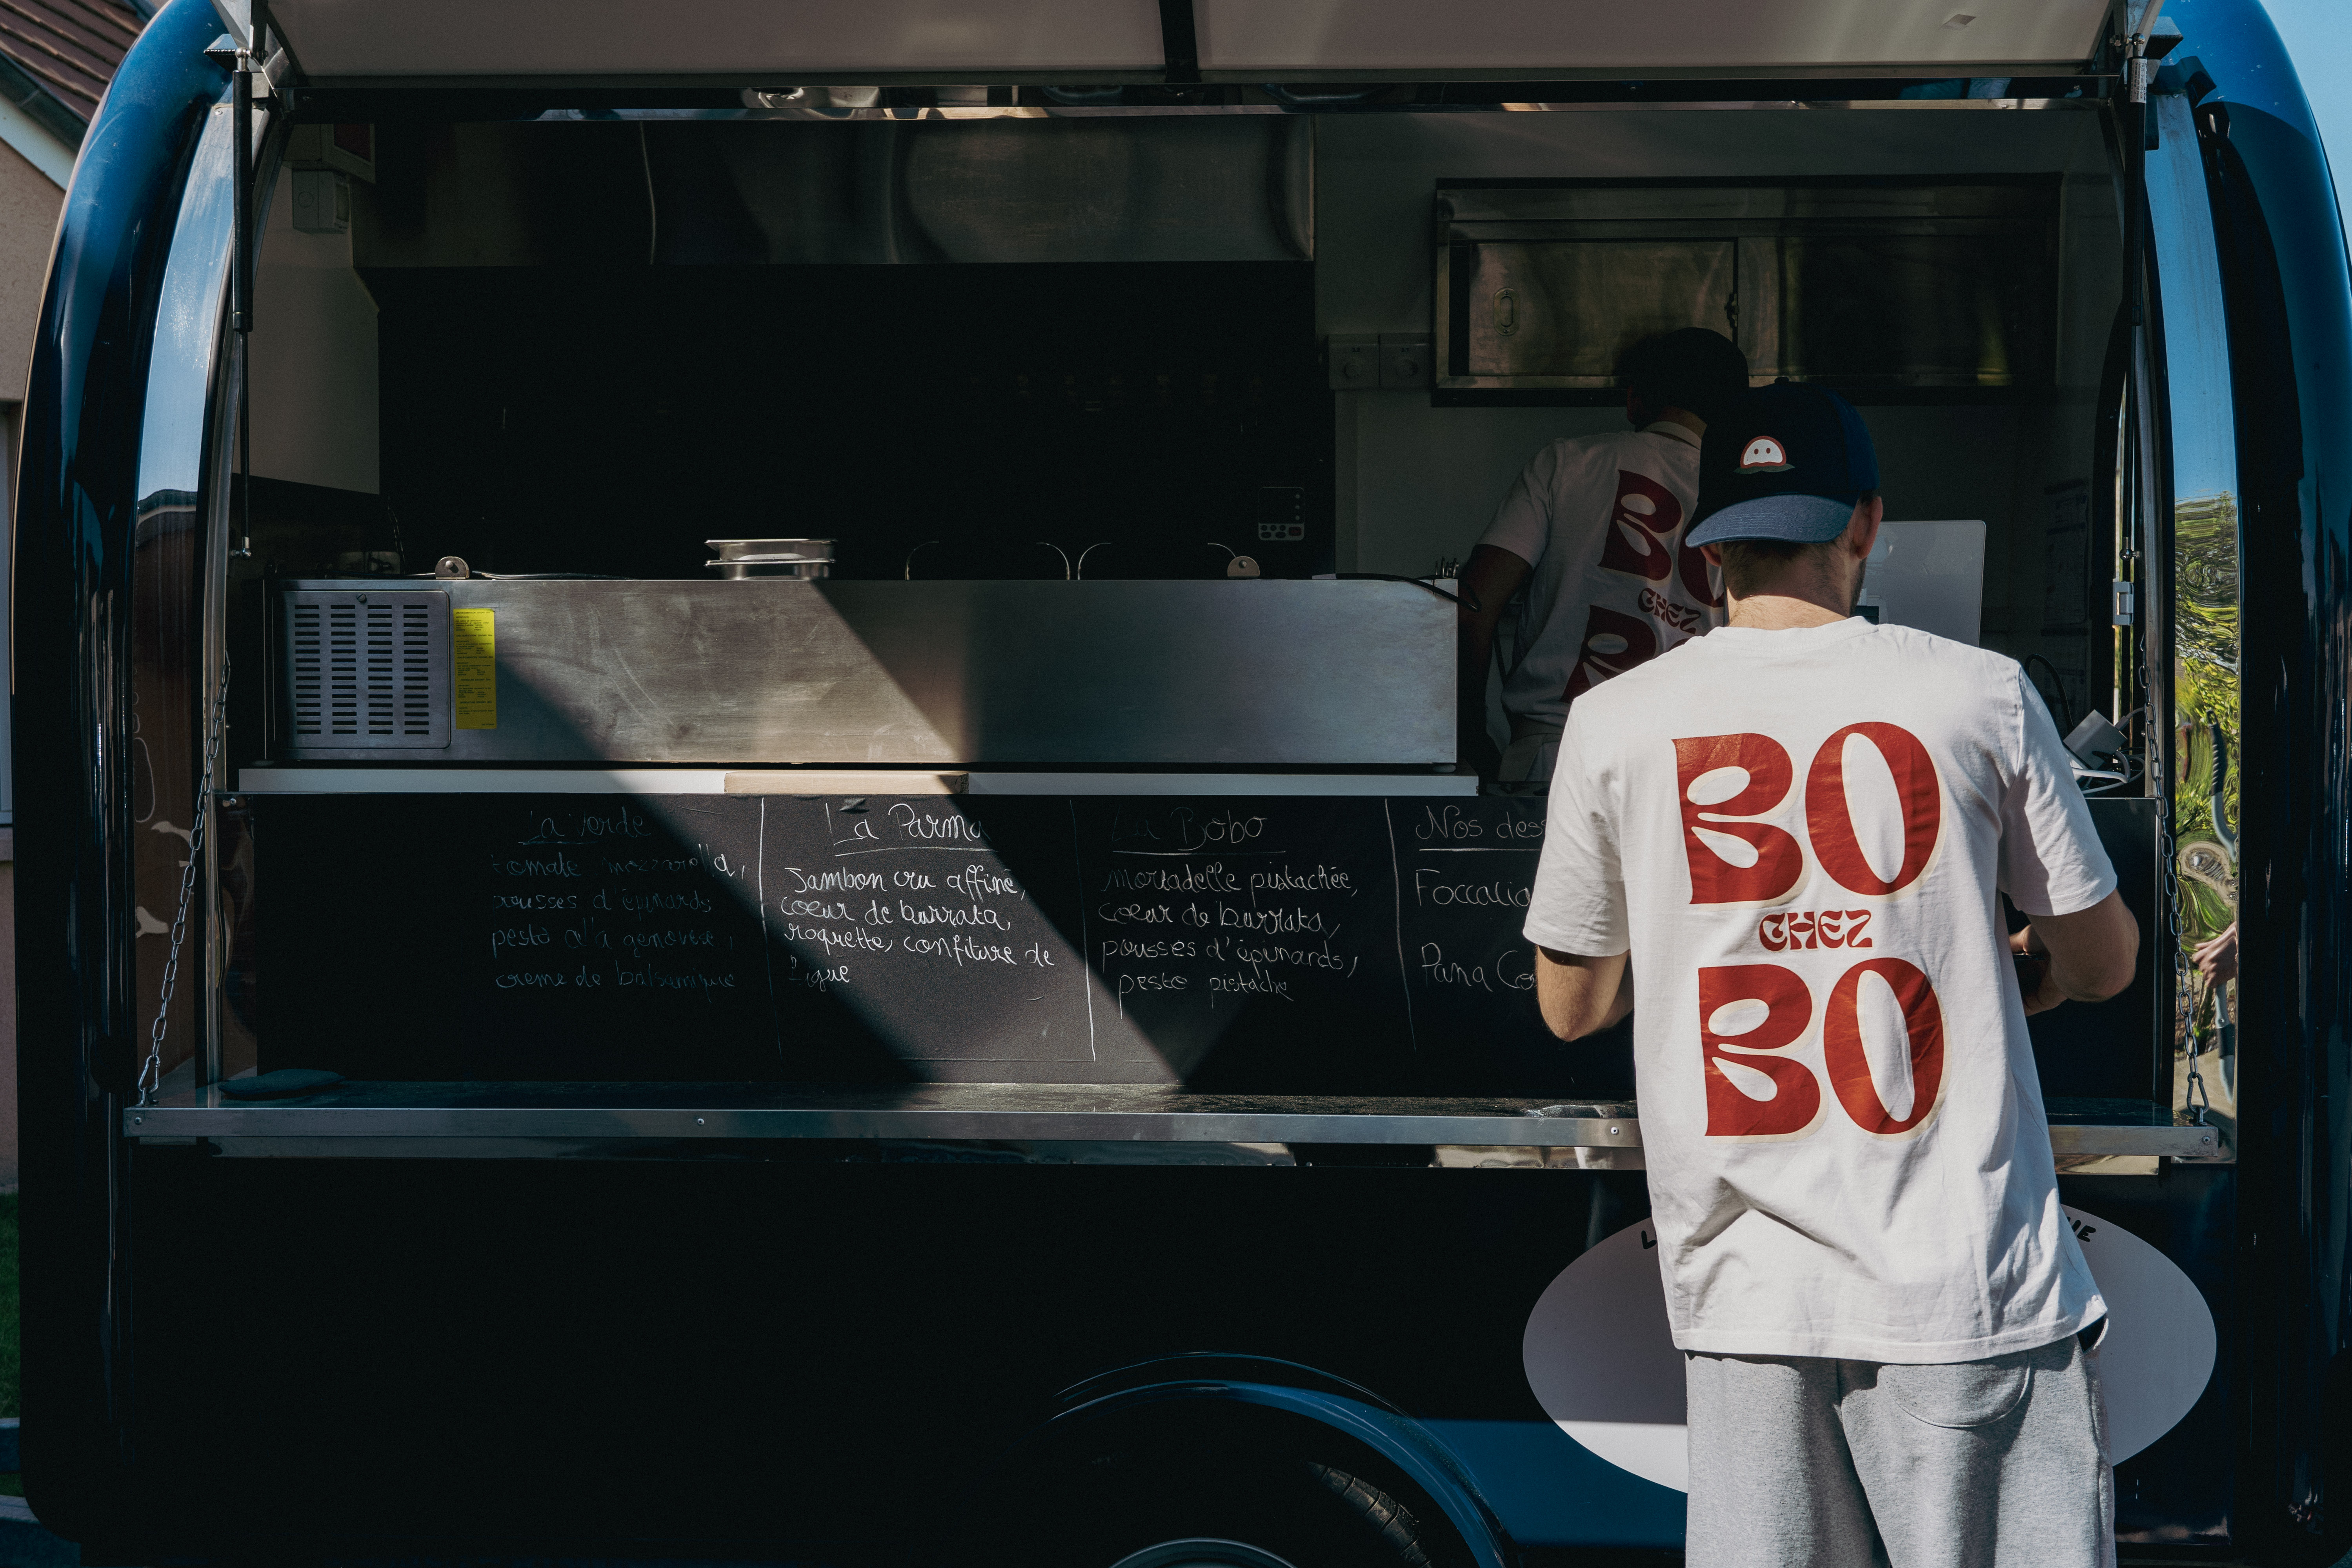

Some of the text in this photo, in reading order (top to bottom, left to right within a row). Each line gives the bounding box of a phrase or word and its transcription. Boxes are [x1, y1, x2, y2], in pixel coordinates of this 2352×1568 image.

[1638, 588, 1701, 635] CHEZ
[826, 803, 992, 846] La Parma
[1111, 806, 1268, 851] La Bobo
[1415, 805, 1483, 840] Nos
[1672, 722, 1941, 905] BO
[784, 866, 888, 893] Jambon
[894, 870, 936, 890] cru
[865, 900, 893, 926] de
[1181, 902, 1211, 927] de
[1759, 910, 1873, 952] CHEZ
[904, 936, 1018, 966] confiture
[1025, 942, 1055, 967] de
[1102, 939, 1196, 973] pousses
[576, 965, 600, 988] de
[1699, 957, 1945, 1137] BO
